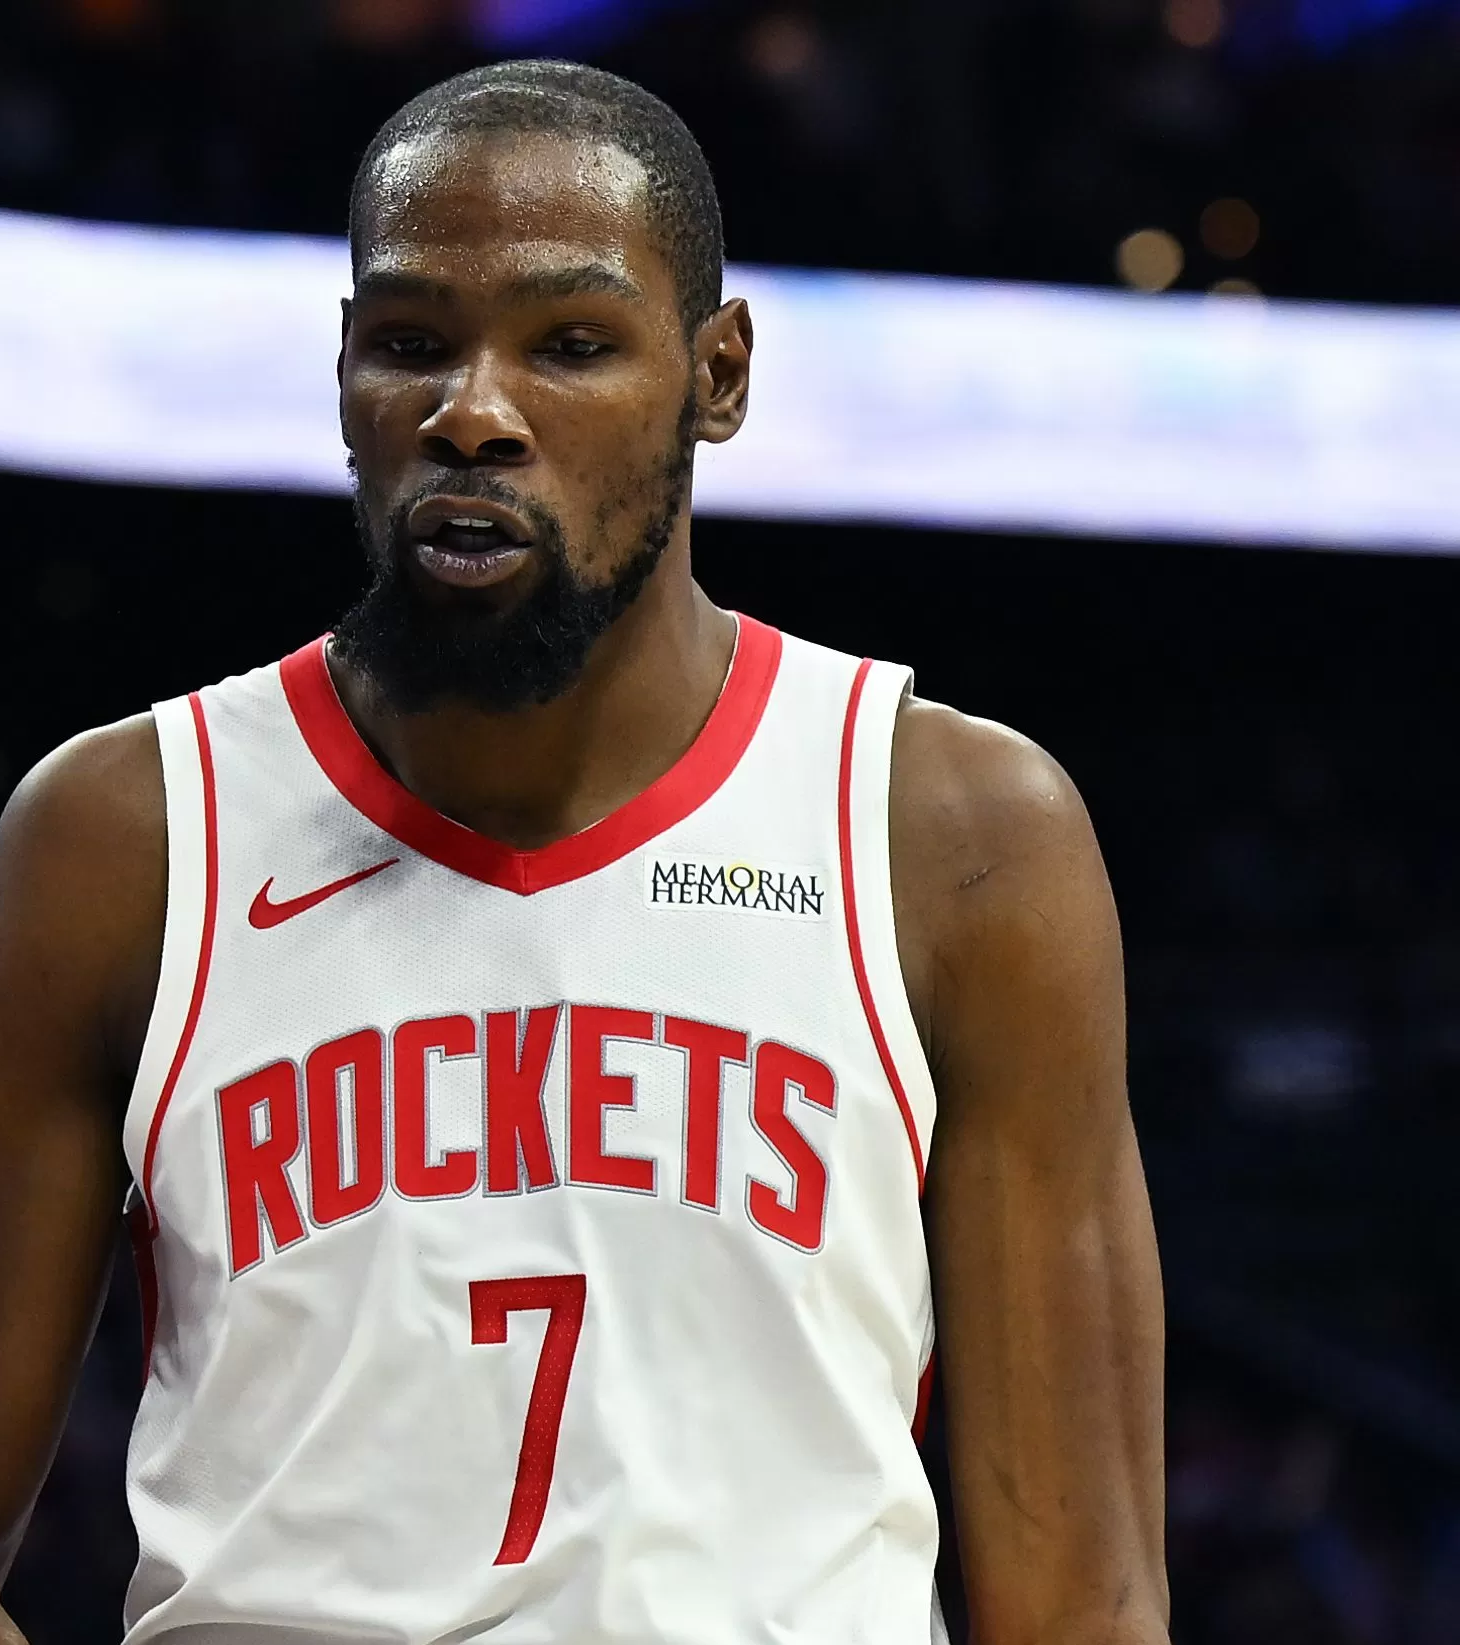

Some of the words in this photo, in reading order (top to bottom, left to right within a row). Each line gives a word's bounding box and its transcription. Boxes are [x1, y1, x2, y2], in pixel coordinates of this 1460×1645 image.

[651, 881, 822, 915] HERMANN
[652, 860, 825, 897] MEMORIAL
[215, 1000, 838, 1281] ROCKETS
[469, 1274, 586, 1566] 7
